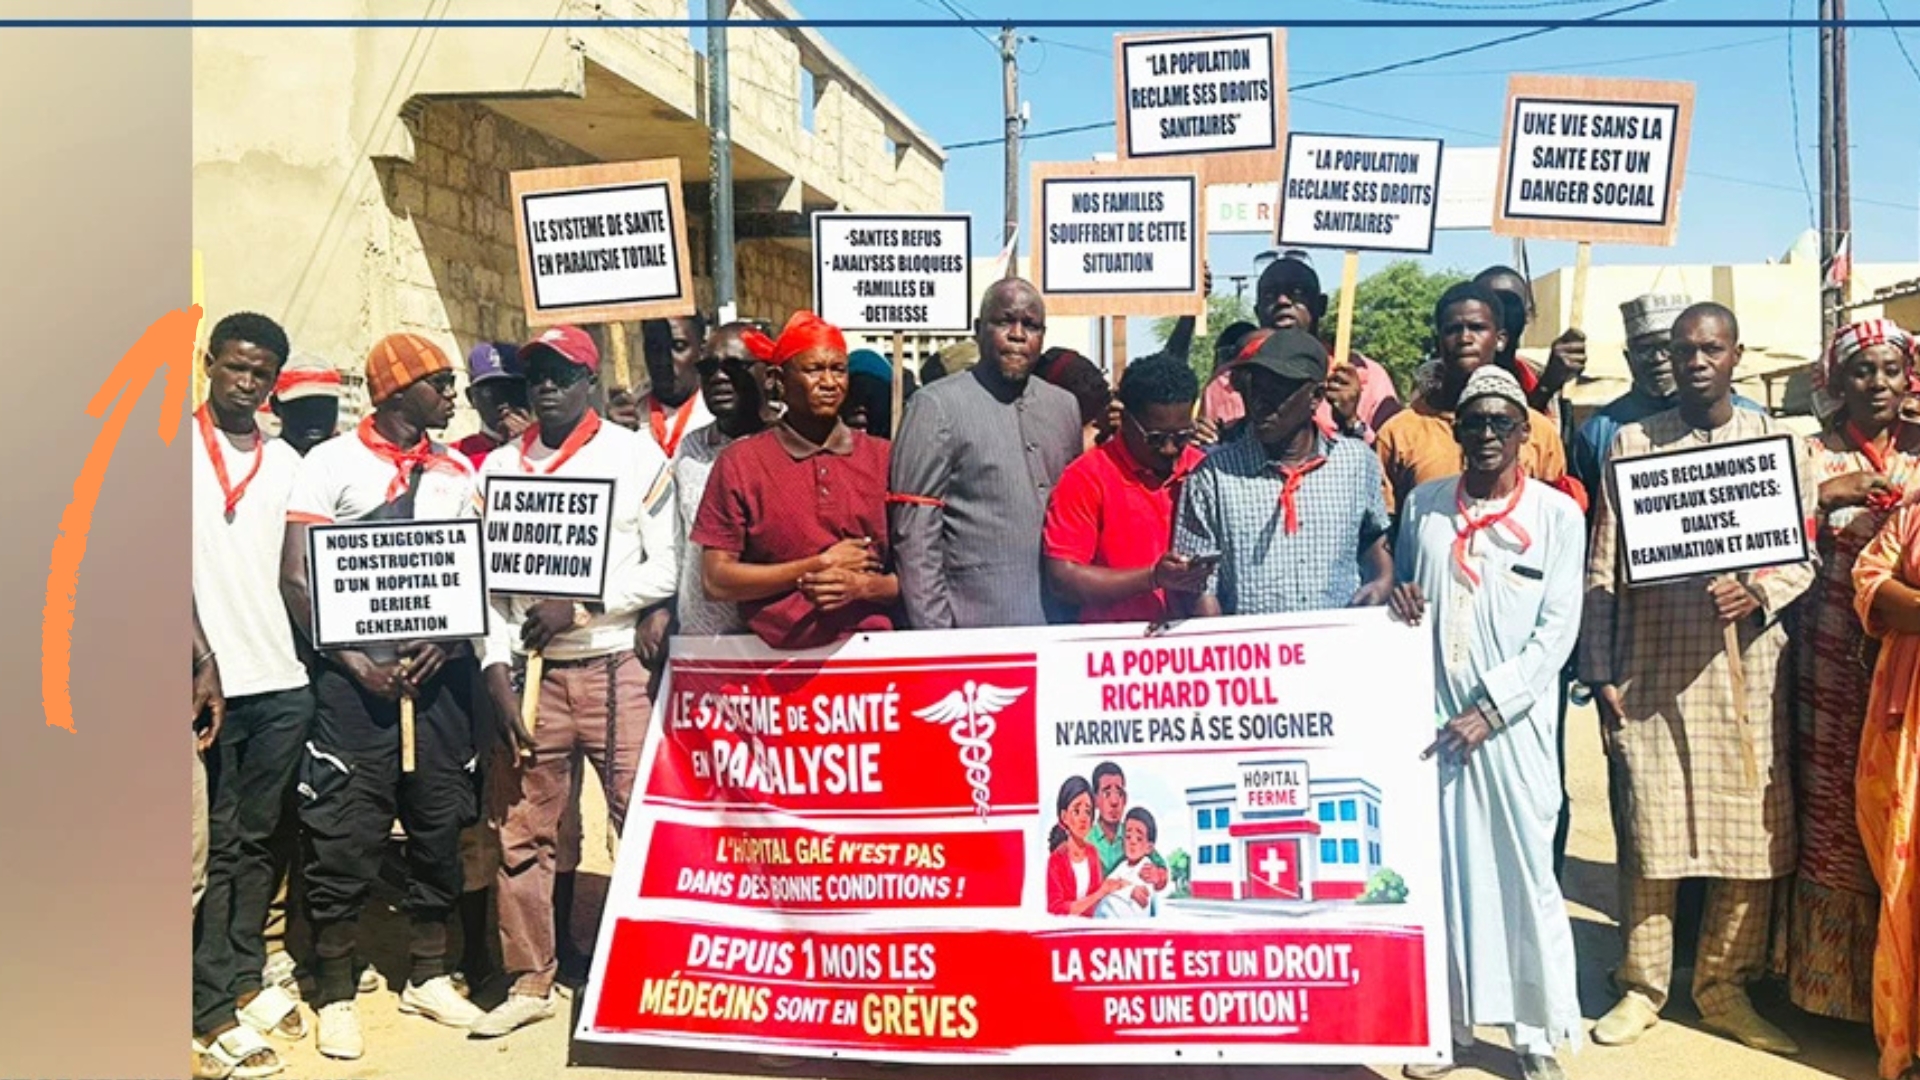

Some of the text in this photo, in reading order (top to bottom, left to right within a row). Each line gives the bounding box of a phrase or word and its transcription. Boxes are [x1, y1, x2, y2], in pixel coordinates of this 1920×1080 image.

[1171, 49, 1250, 74] POPULATION
[1132, 79, 1268, 109] RECLAME SES DROITS
[1524, 112, 1662, 140] UNE VIE SANS LA
[1334, 150, 1419, 173] POPULATION
[1533, 146, 1650, 173] SANTE EST UN
[1072, 192, 1164, 213] NOS FAMILLES
[1289, 179, 1431, 206] RECLAME SES DROITS
[1520, 179, 1654, 206] DANGER SOCIAL
[533, 210, 665, 242] LE SYSTEME DE SANTE
[902, 230, 941, 247] REFUS
[1050, 222, 1186, 244] SOUFFRENT DE CETTE
[537, 244, 667, 276] EN PARALYSIE TOTALE
[832, 255, 895, 272] ANALYSES
[898, 255, 962, 273] BLOQUEES
[1083, 252, 1153, 273] SITUATION
[920, 280, 934, 296] EN
[1630, 453, 1777, 490] NOUS RECLAMONS DE
[494, 491, 598, 514] LA SANTE EST
[1634, 479, 1781, 515] NOUVEAUX SERVICES:
[326, 530, 465, 549] NOUS EXIGEONS LA
[488, 521, 598, 546] UN DROIT, PAS
[1632, 539, 1724, 565] REANIMATION
[1728, 535, 1742, 553] ET
[1746, 528, 1790, 550] AUTRE
[337, 552, 455, 571] CONSTRUCTION
[491, 552, 591, 577] UNE OPINION
[335, 572, 460, 592] D'UN HOPITAL DE
[370, 595, 430, 613] DERIERE
[356, 615, 447, 635] GENERATION
[1087, 642, 1306, 678] LA POPULATION DE
[1102, 677, 1278, 711] RICHARD TOLL
[673, 693, 692, 728] LE
[787, 706, 809, 732] DE
[812, 683, 900, 734] SANTÉ
[1056, 720, 1144, 746] N'ARRIVE
[1150, 718, 1185, 742] PAS
[1209, 715, 1233, 740] SE
[1239, 712, 1334, 739] SOIGNER
[693, 739, 882, 795] EN PARALYSIE
[1248, 790, 1297, 806] FERME
[795, 834, 835, 864] GAÉ
[839, 841, 900, 865] N'EST
[904, 843, 946, 868] PAS
[676, 868, 734, 898] DANS
[738, 875, 770, 899] DES
[772, 875, 822, 902] BONNE
[826, 873, 950, 902] CONDITIONS
[687, 934, 935, 980] DEPUIS 1 MOIS LES
[1052, 940, 1359, 983] LA SANTÉ EST UN DROIT,
[638, 970, 771, 1023] MÉDECINS
[774, 996, 828, 1023] SONT
[831, 999, 857, 1025] EN
[1105, 997, 1145, 1024] PAS
[1150, 996, 1194, 1023] UNE
